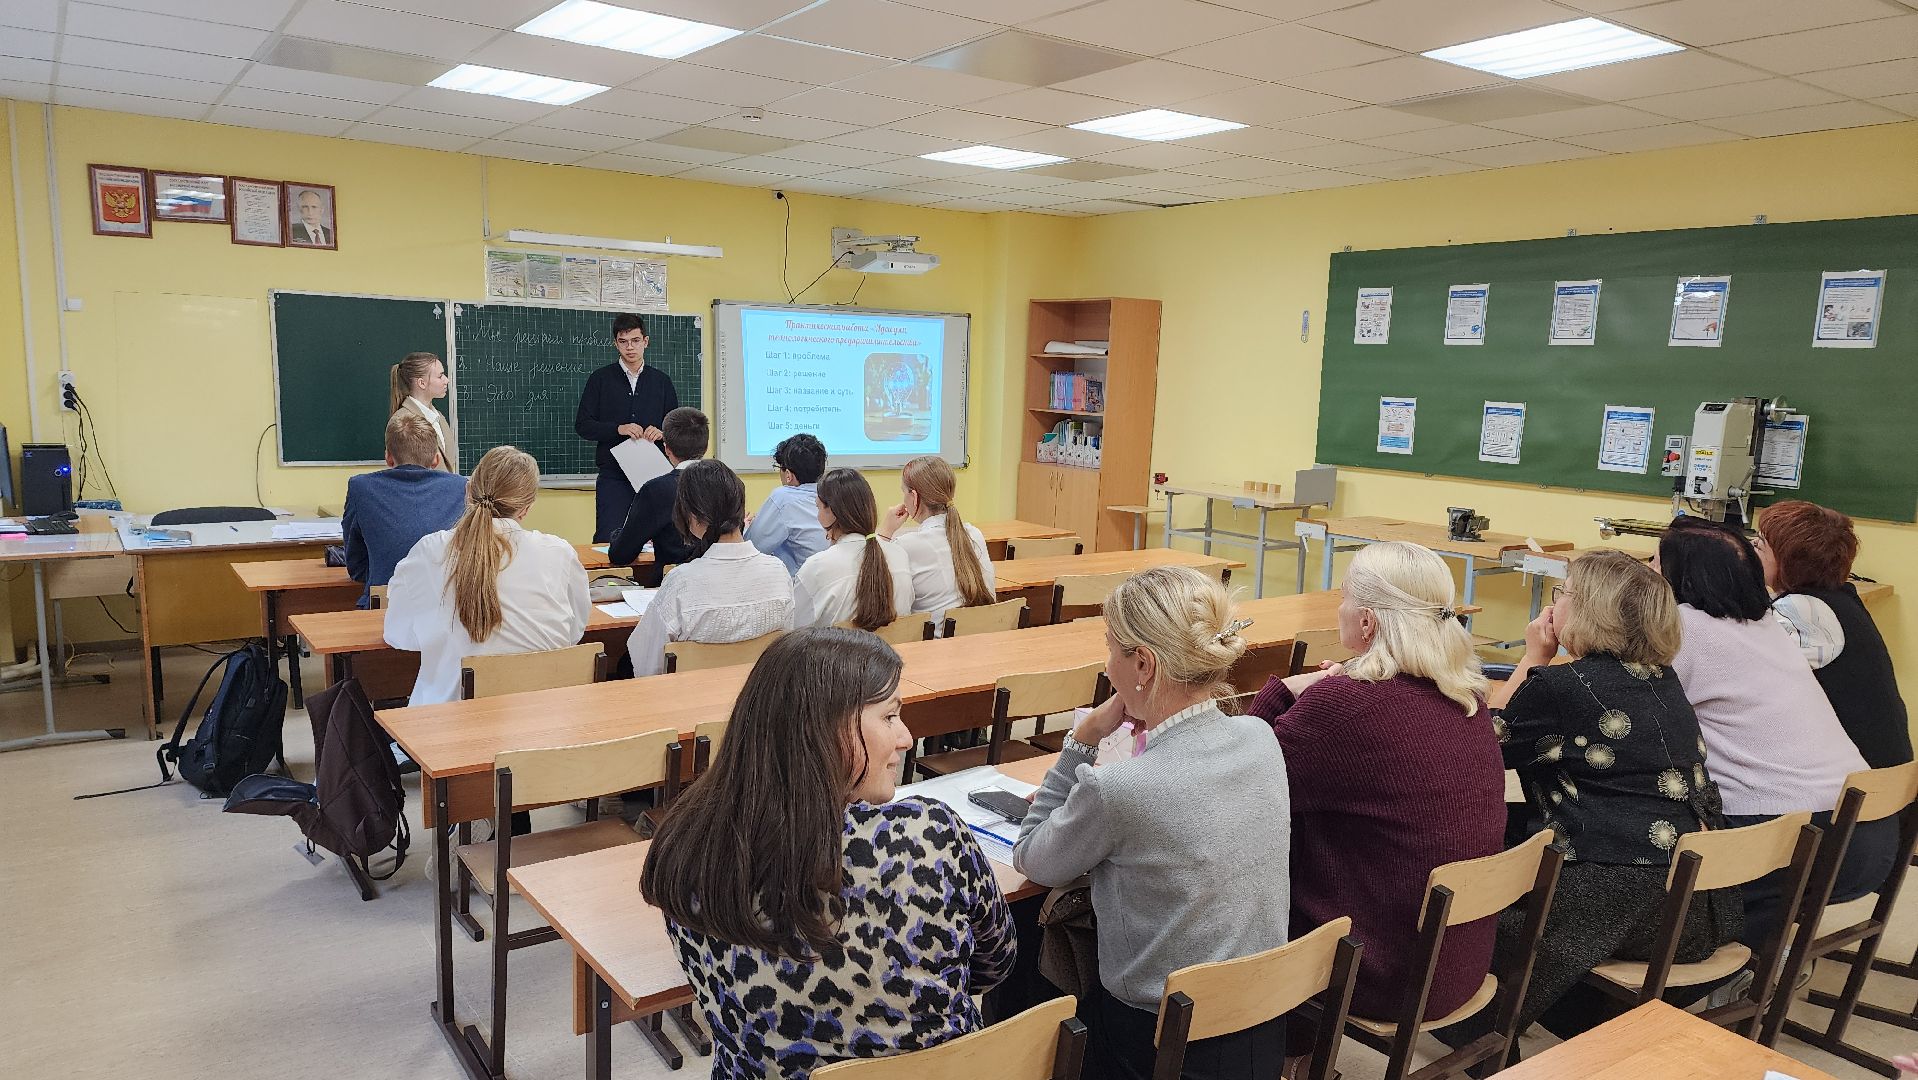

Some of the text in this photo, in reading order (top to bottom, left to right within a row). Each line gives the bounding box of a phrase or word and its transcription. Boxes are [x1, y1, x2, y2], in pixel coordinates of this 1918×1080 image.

[765, 351, 830, 361] Шаг 1: проблема
[766, 369, 826, 380] Шаг 2: решение
[766, 386, 782, 395] Шаг
[784, 386, 792, 395] 3:
[793, 387, 828, 396] название
[767, 403, 842, 414] Шаг 4: потребитель
[768, 421, 820, 431] Шаг 5: деньги
